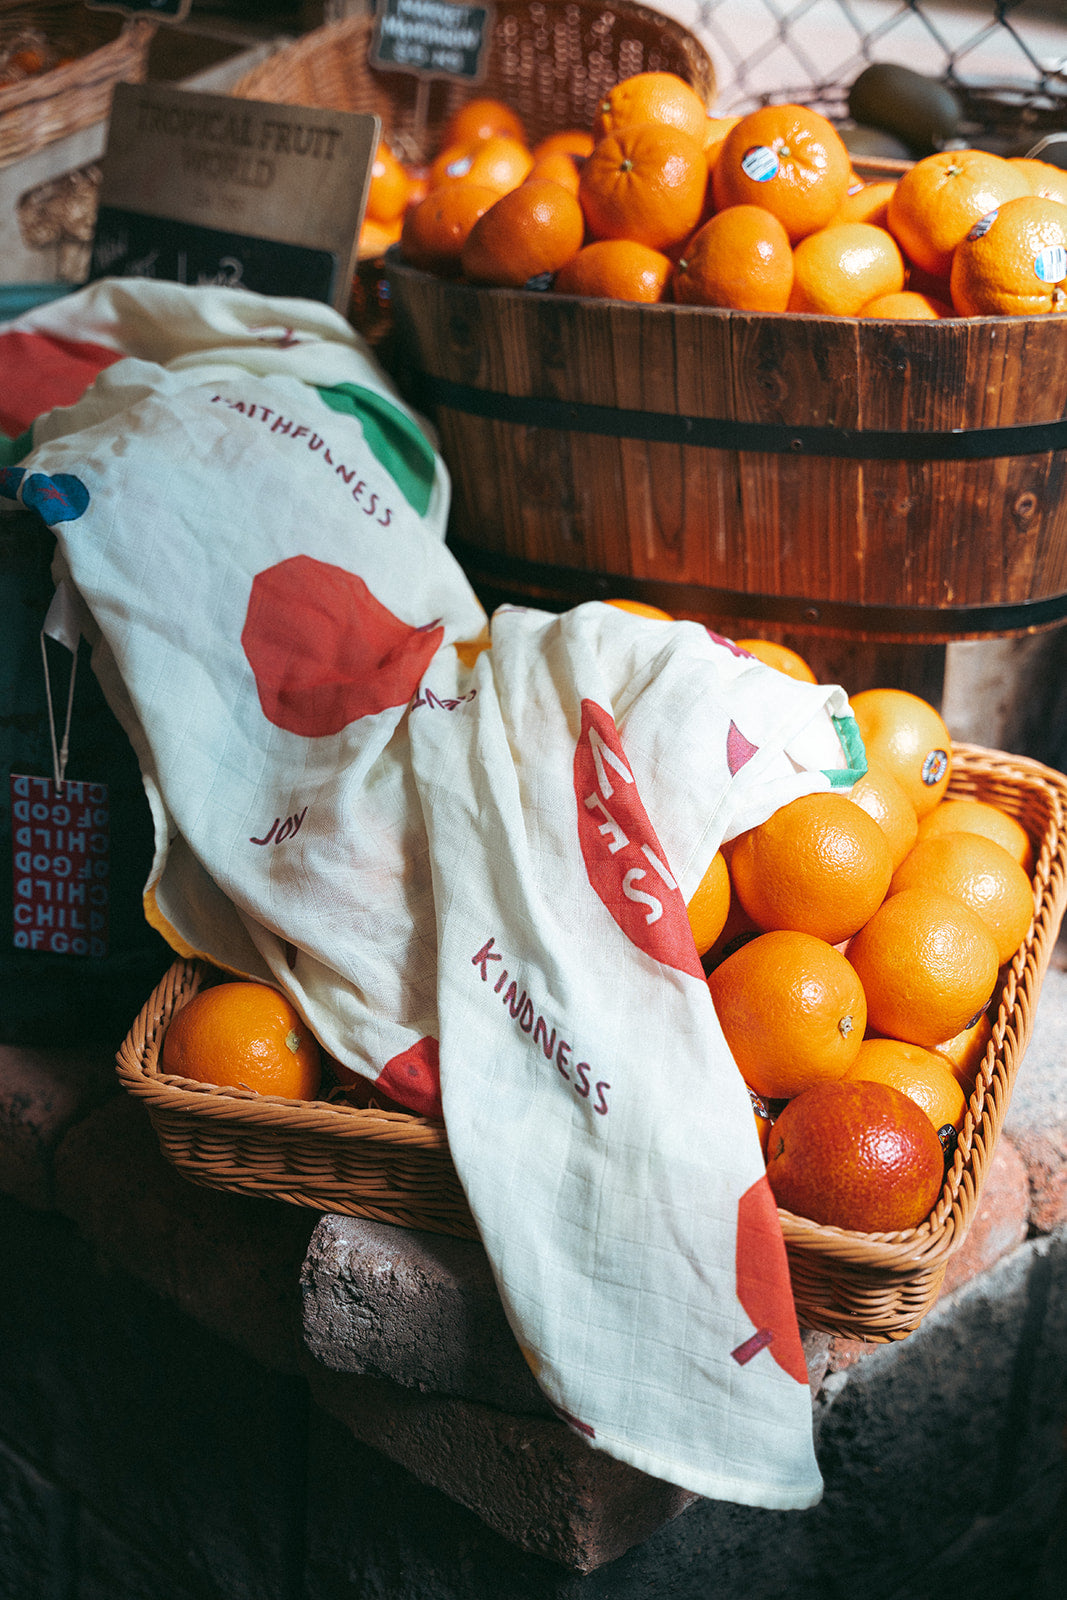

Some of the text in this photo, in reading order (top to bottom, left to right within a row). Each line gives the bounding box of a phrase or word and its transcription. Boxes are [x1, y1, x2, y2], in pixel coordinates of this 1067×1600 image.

[137, 102, 343, 161] TROPICAL FRUIT
[183, 146, 277, 189] WORLD
[13, 777, 108, 804] CHLD
[13, 801, 72, 827] GOD
[249, 806, 309, 846] JOY
[15, 826, 109, 855] CHILD
[15, 852, 73, 878] GOD
[16, 877, 109, 906] CHILD
[14, 903, 105, 932] CHILD
[13, 930, 108, 957] OF GOD
[471, 937, 612, 1117] KINDNESS
